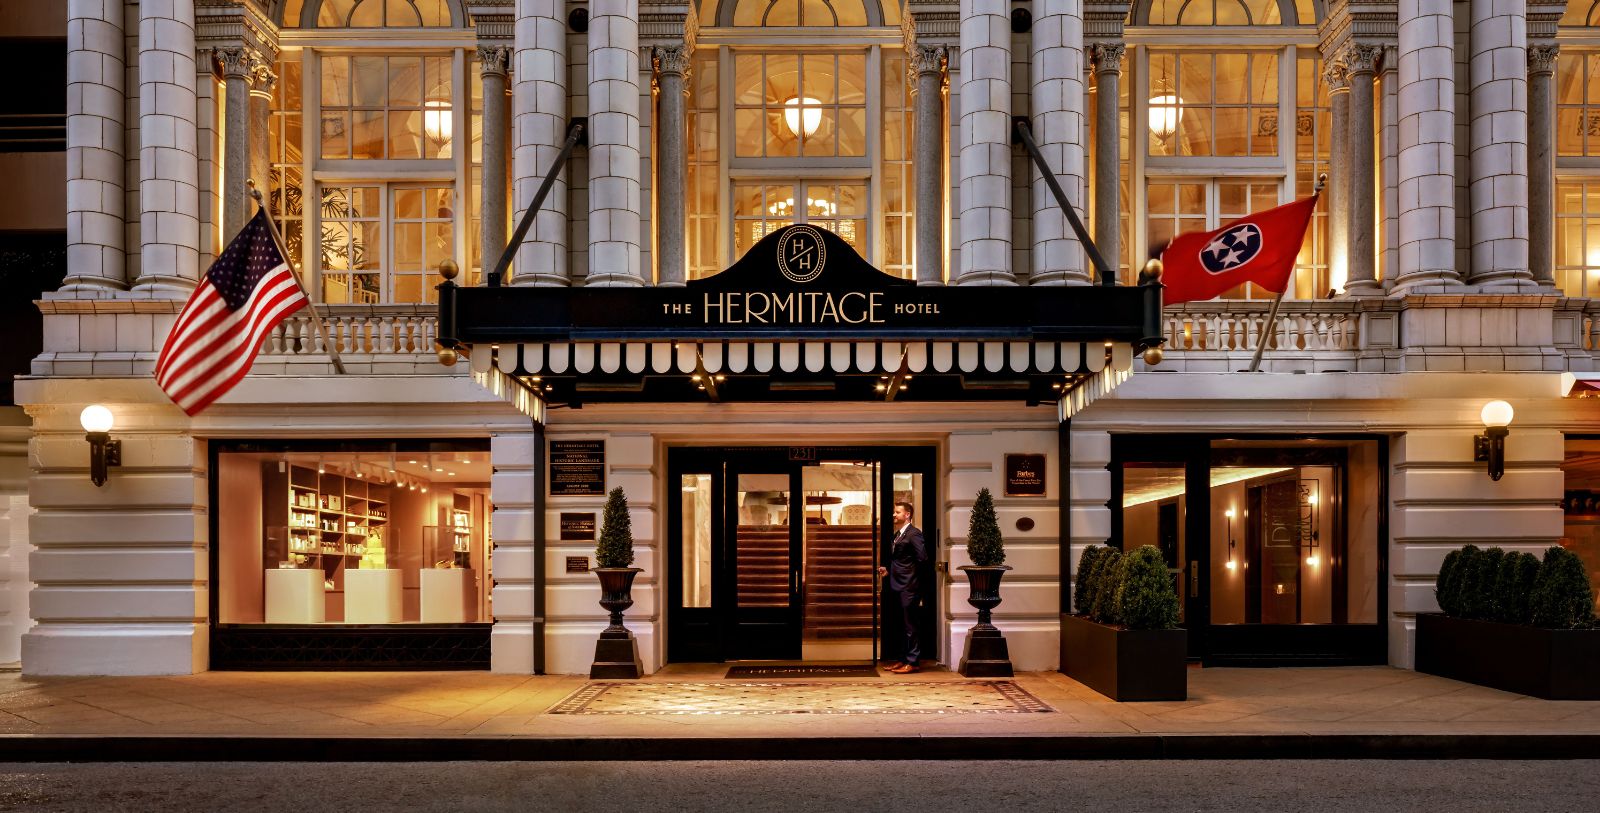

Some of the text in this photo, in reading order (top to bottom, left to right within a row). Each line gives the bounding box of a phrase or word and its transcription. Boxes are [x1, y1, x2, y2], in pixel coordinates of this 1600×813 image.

[792, 239, 804, 254] H
[800, 253, 811, 270] H
[663, 292, 940, 324] THE HERMITAGE HOTEL
